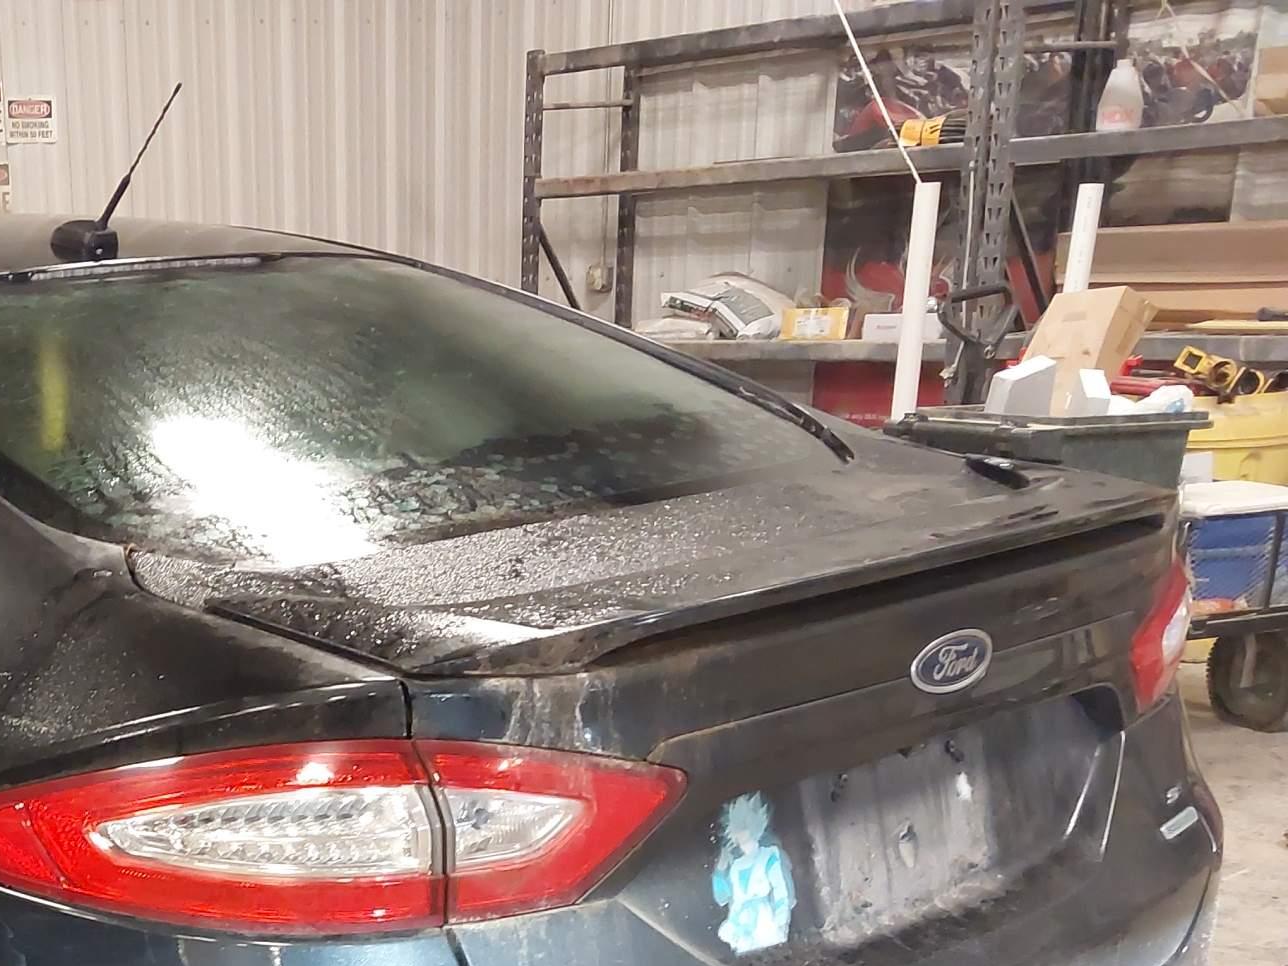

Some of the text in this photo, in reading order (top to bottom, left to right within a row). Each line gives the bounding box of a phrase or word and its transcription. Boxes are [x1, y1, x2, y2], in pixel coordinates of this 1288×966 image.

[12, 103, 47, 114] DANGER
[12, 120, 49, 129] NO SMOKING
[39, 129, 53, 139] FEET
[933, 643, 978, 681] Ford
